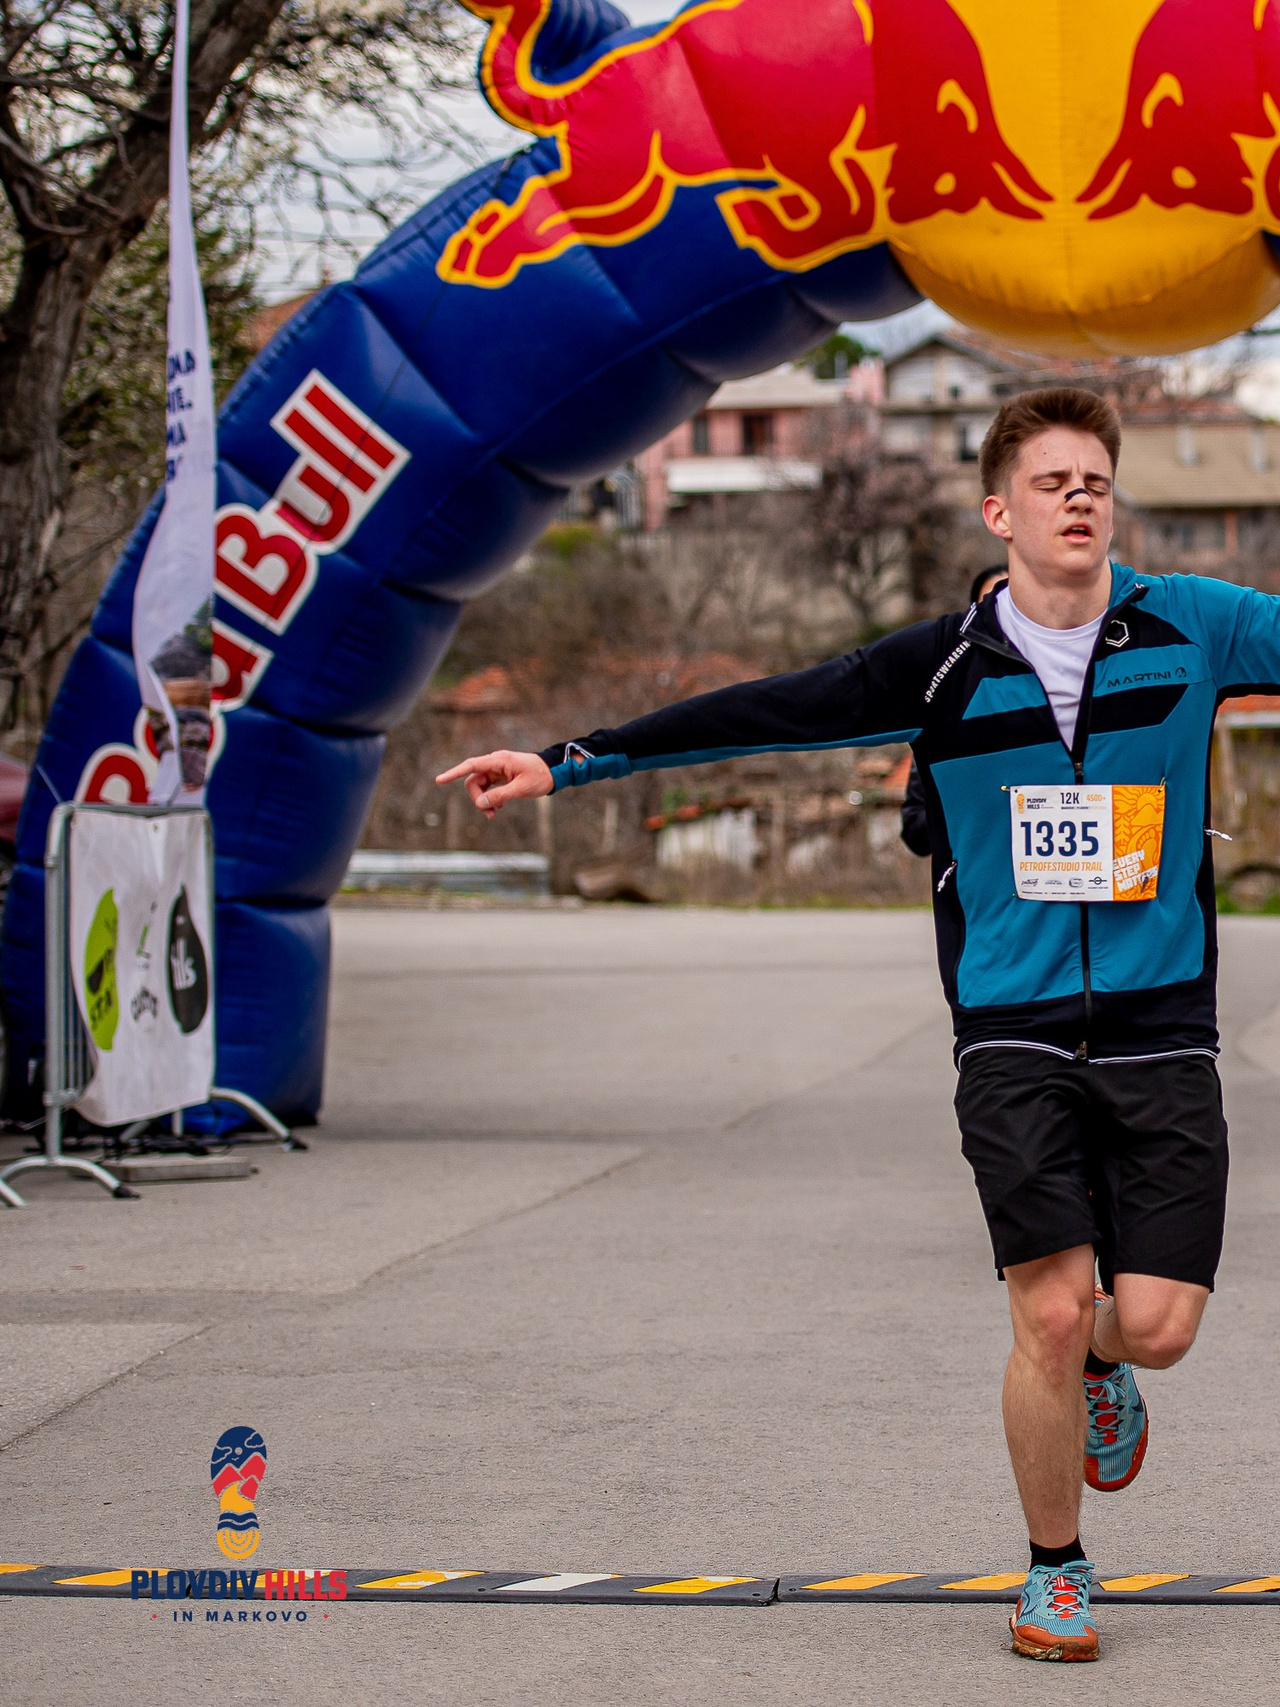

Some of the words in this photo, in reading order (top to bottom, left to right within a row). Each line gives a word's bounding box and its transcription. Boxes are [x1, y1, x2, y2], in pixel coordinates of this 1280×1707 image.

[216, 385, 396, 620] Bull
[1107, 671, 1172, 687] MARTINI
[1060, 792, 1080, 804] 12K
[1020, 821, 1099, 857] 1335
[1081, 862, 1103, 871] TRAIL
[1114, 863, 1140, 880] STEP
